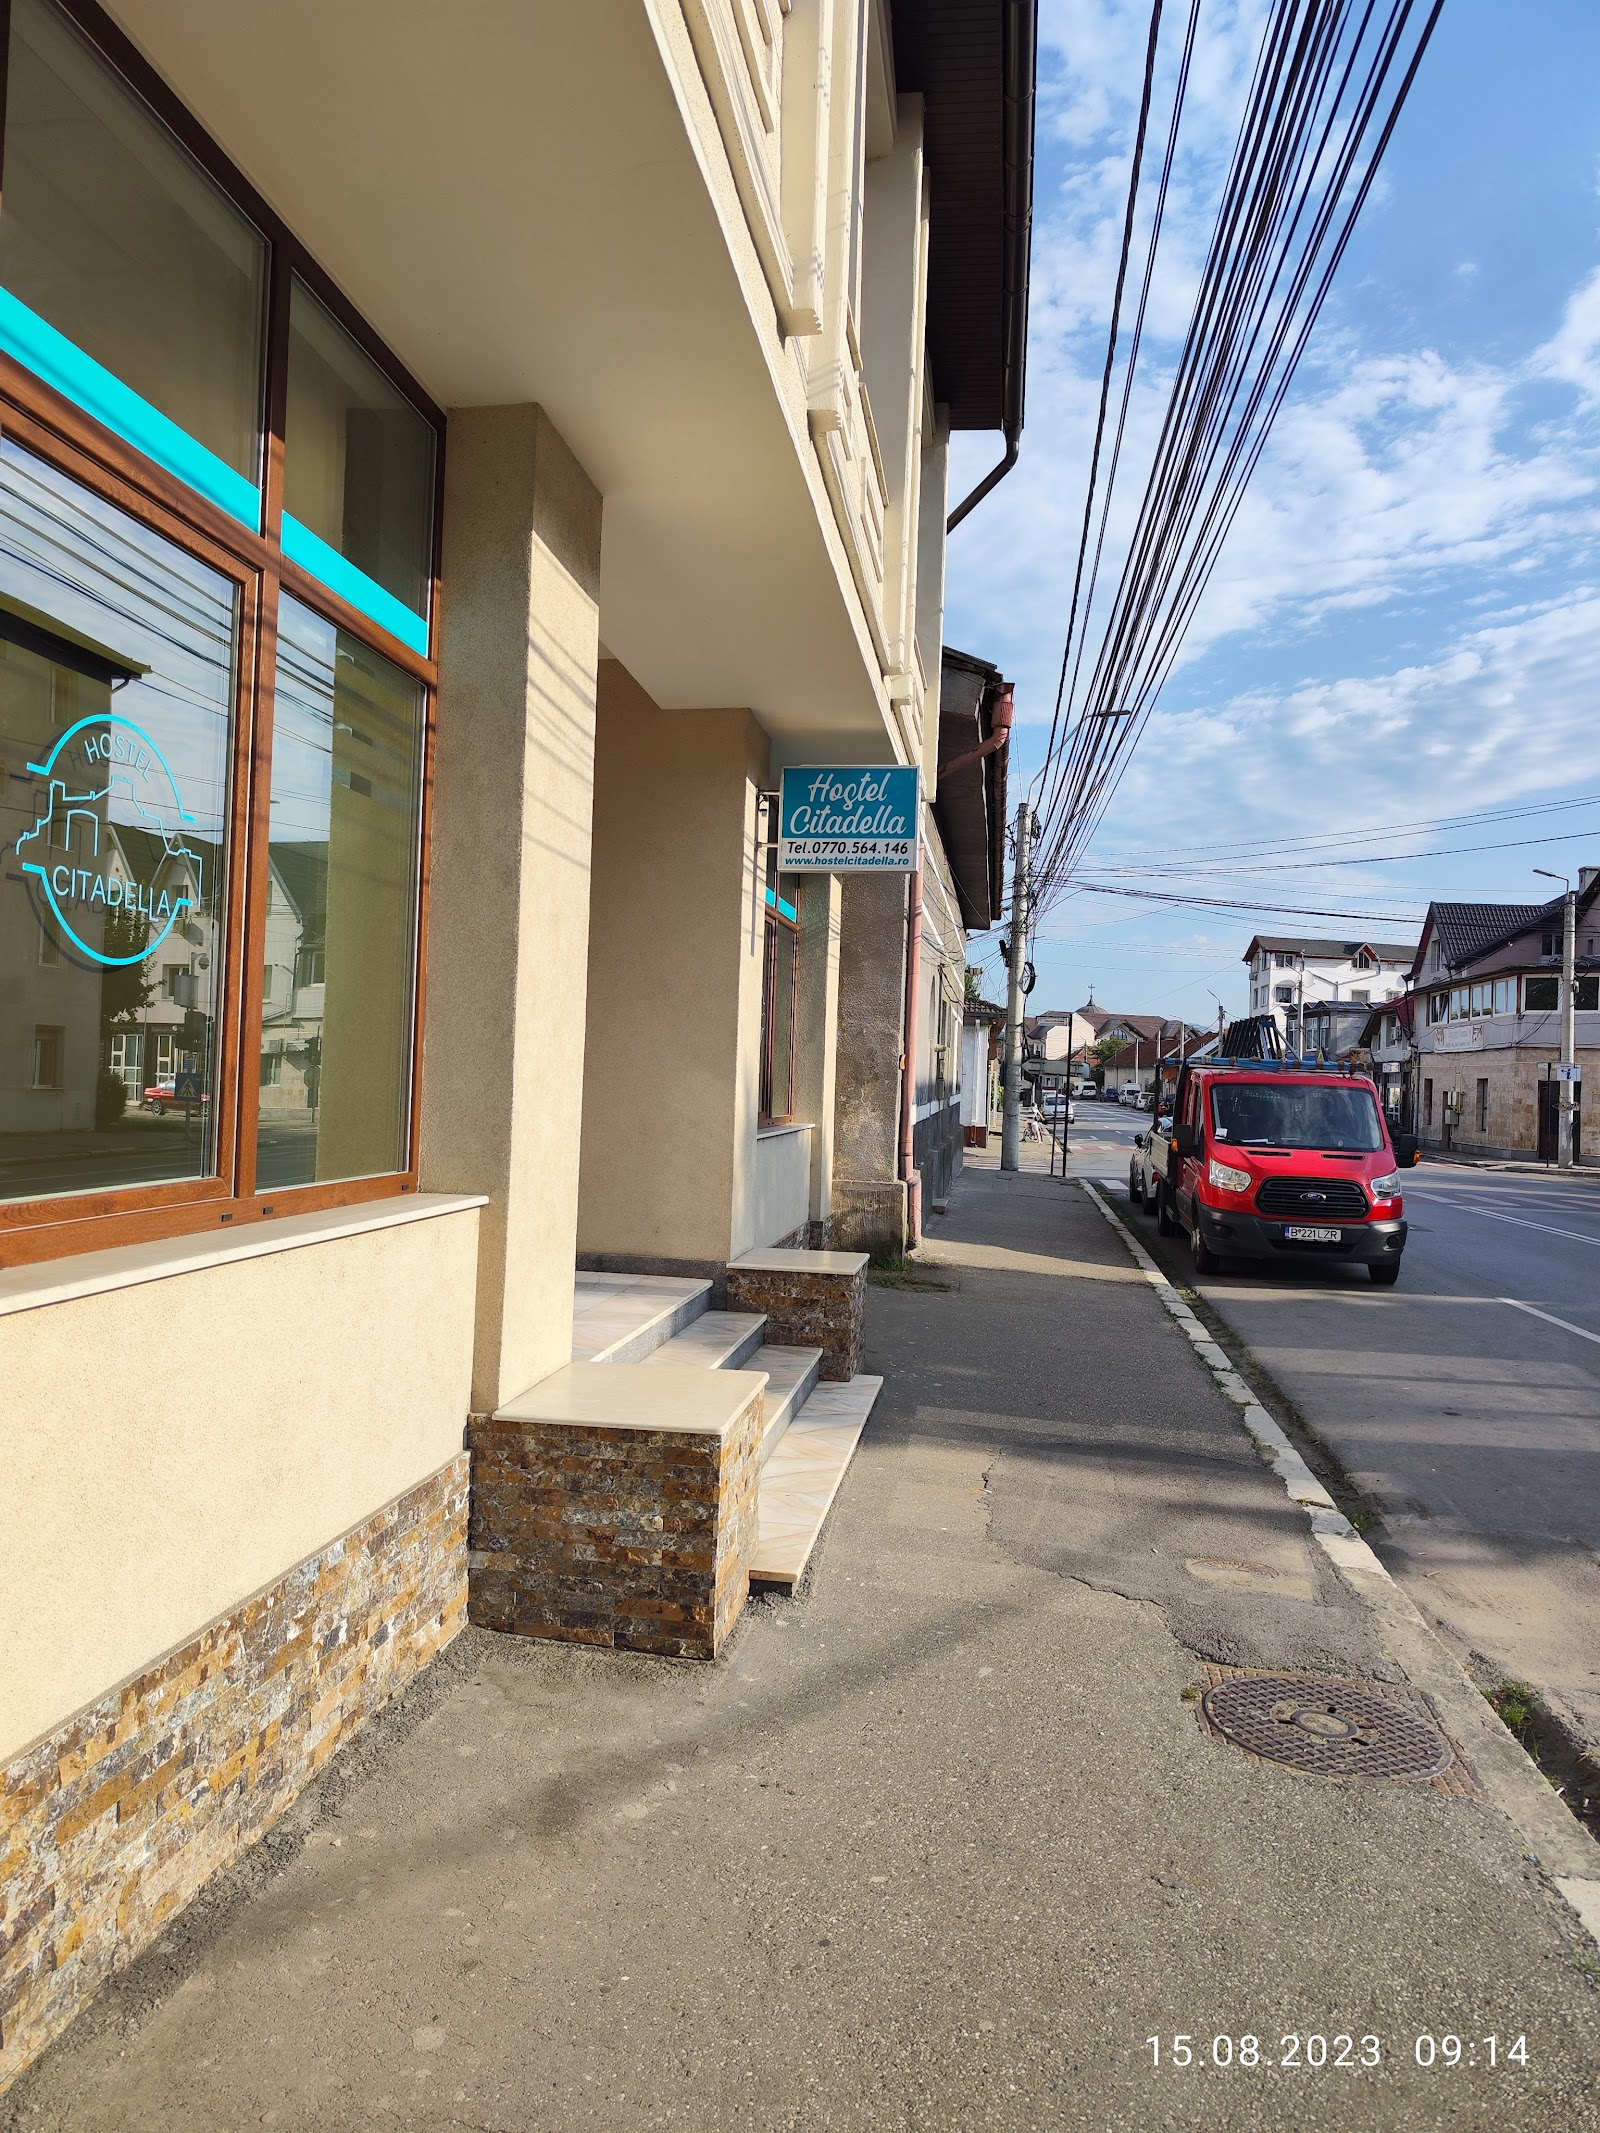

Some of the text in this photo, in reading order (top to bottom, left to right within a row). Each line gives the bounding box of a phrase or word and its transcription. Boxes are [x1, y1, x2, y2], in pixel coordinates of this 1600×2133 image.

[84, 733, 152, 783] HOSTEL
[808, 772, 891, 810] Hostel
[790, 804, 907, 835] Citadella
[785, 856, 909, 865] www.hostelcitadella.ro
[787, 841, 908, 854] Tel.0770.564.146
[52, 864, 171, 922] CITADELLA
